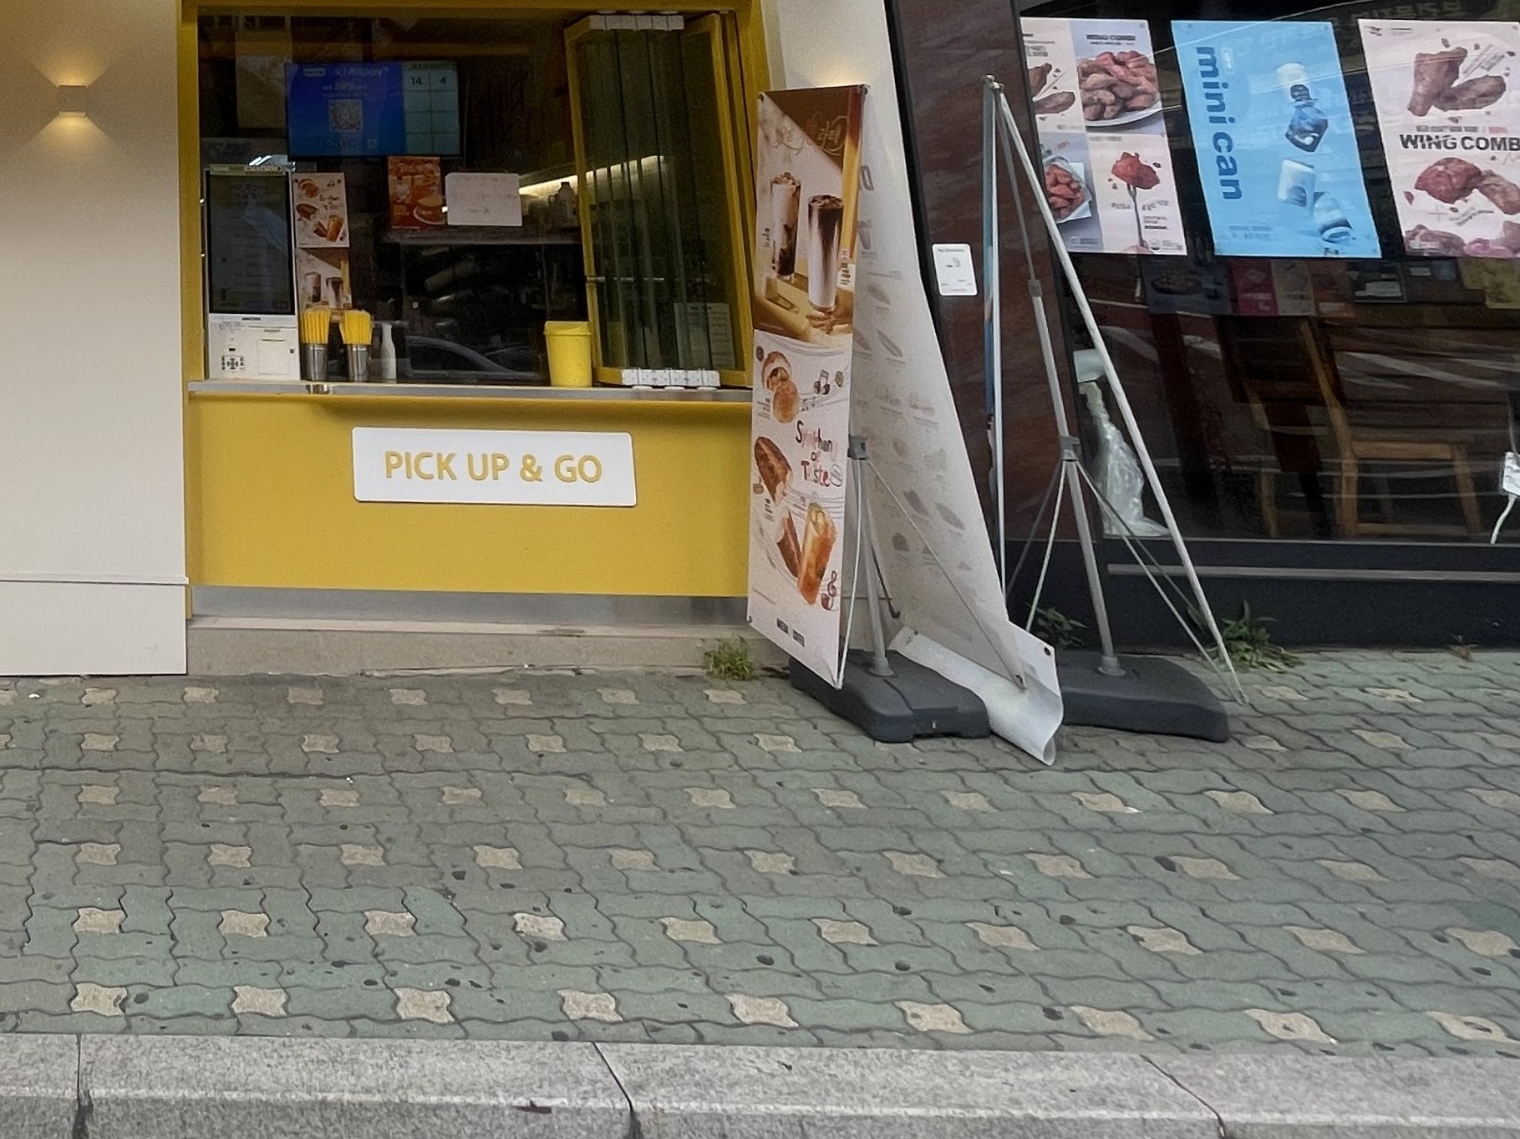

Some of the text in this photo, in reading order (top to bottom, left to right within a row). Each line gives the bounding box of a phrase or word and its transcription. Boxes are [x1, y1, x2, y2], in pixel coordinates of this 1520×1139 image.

[1196, 46, 1243, 200] mini can
[1399, 134, 1457, 151] WING
[384, 450, 603, 484] PICK UP & GO
